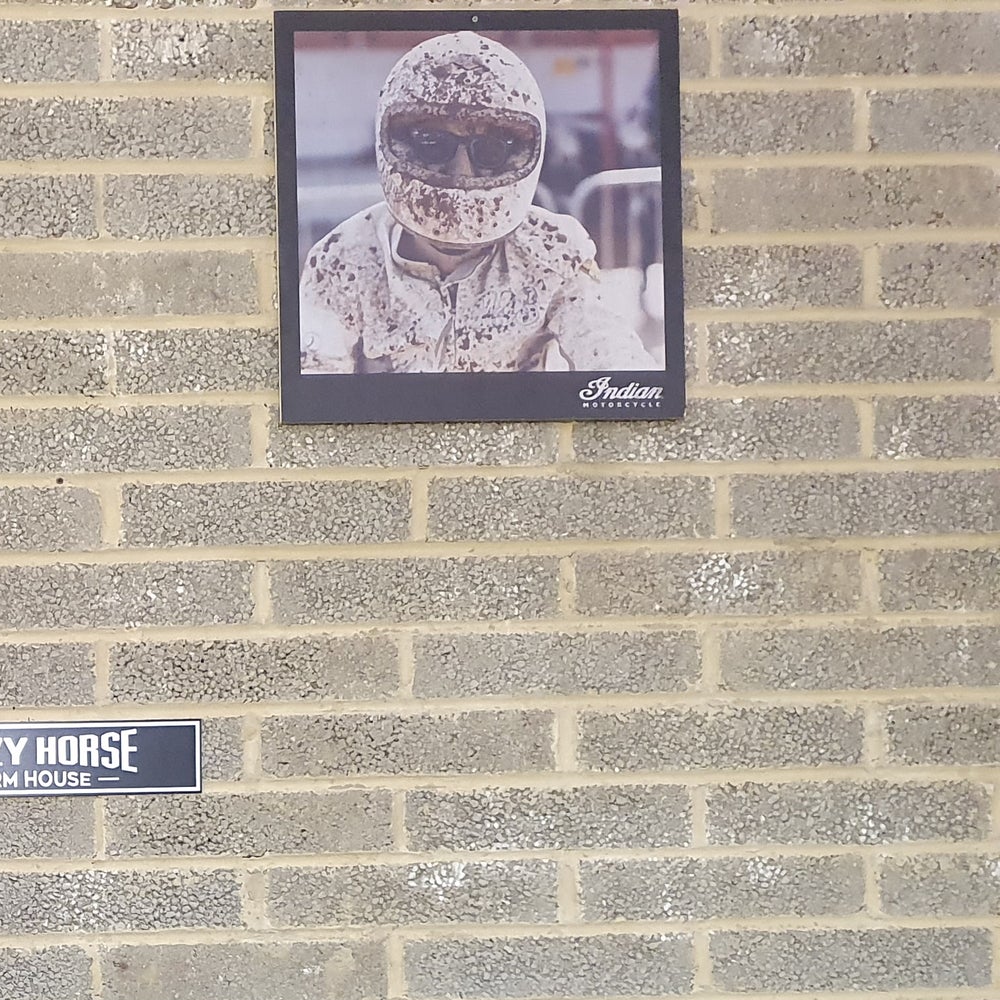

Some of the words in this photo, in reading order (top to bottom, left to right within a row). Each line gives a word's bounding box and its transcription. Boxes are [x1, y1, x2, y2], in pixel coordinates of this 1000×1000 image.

[579, 376, 664, 401] Indian
[36, 728, 138, 773] HORSE
[24, 770, 92, 788] HOUSE
